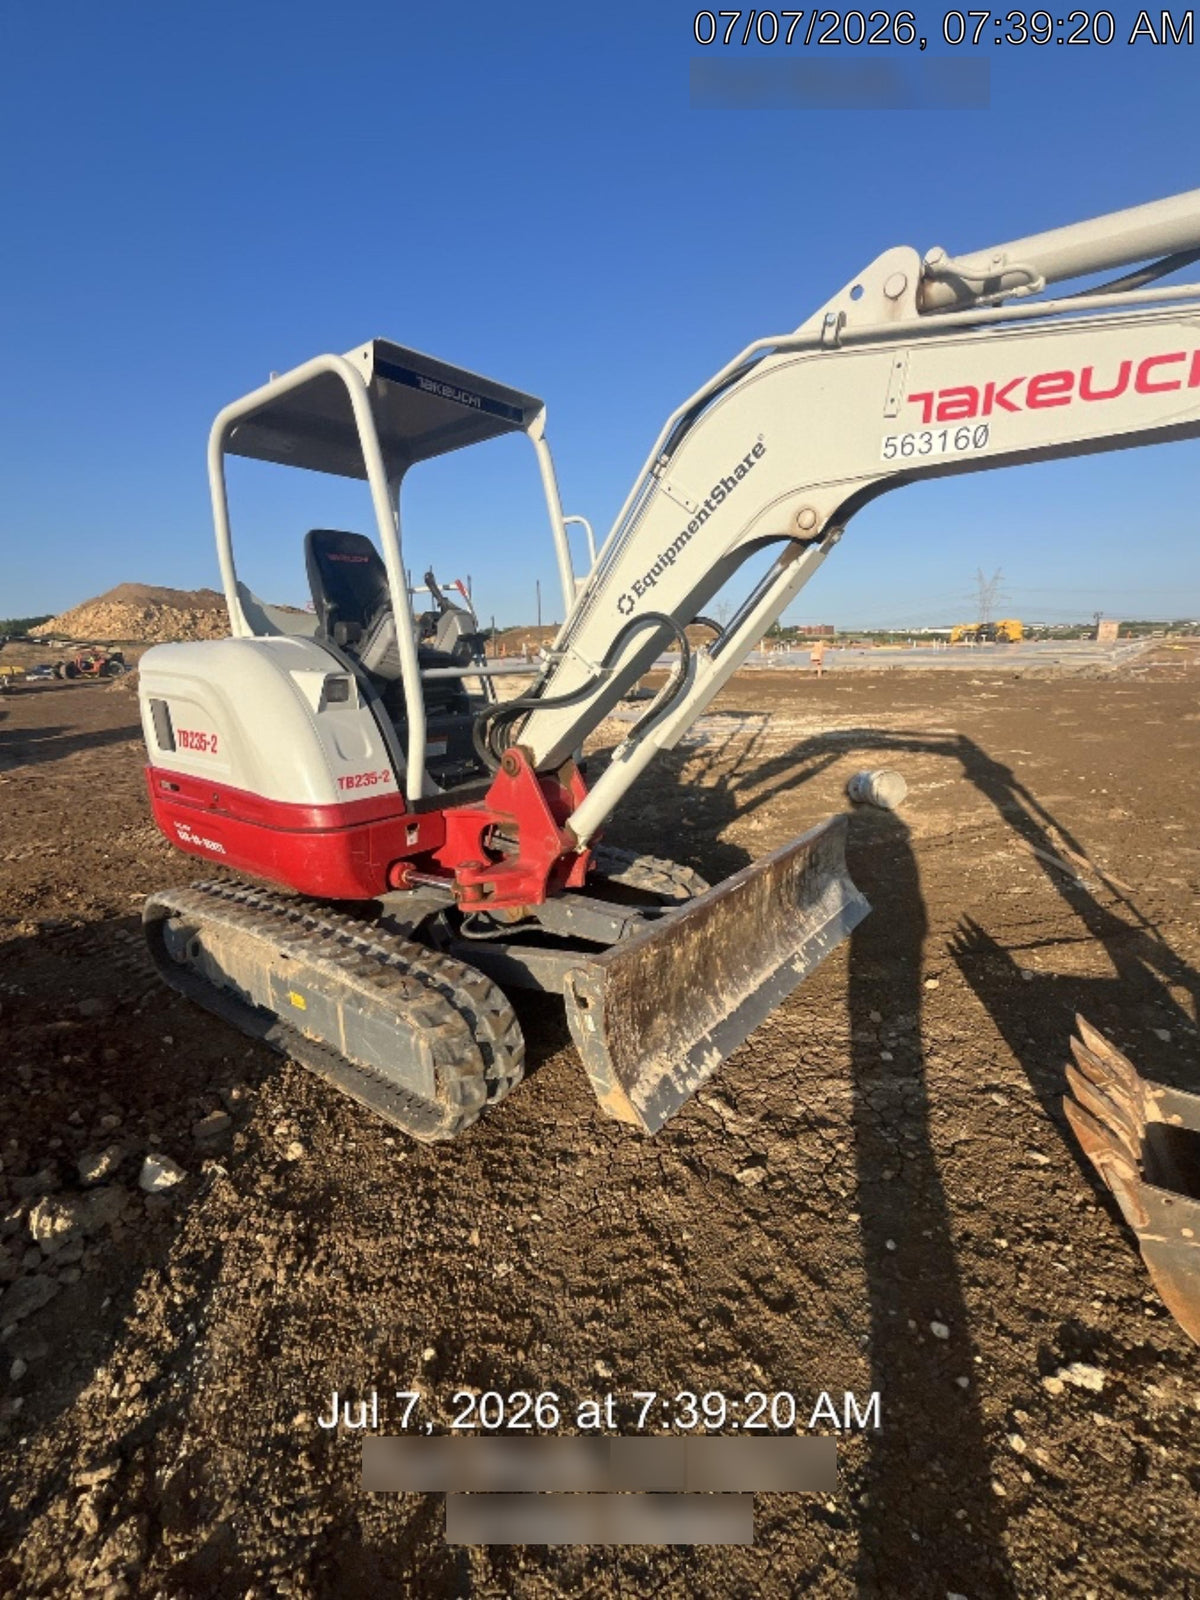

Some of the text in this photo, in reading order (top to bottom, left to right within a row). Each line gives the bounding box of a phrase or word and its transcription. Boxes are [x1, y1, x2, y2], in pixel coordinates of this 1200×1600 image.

[907, 350, 1200, 424] TAKEUC
[883, 423, 990, 459] 563160
[631, 441, 767, 599] EquipmentShare
[177, 729, 218, 754] TB235-2
[338, 769, 390, 790] TB235-2
